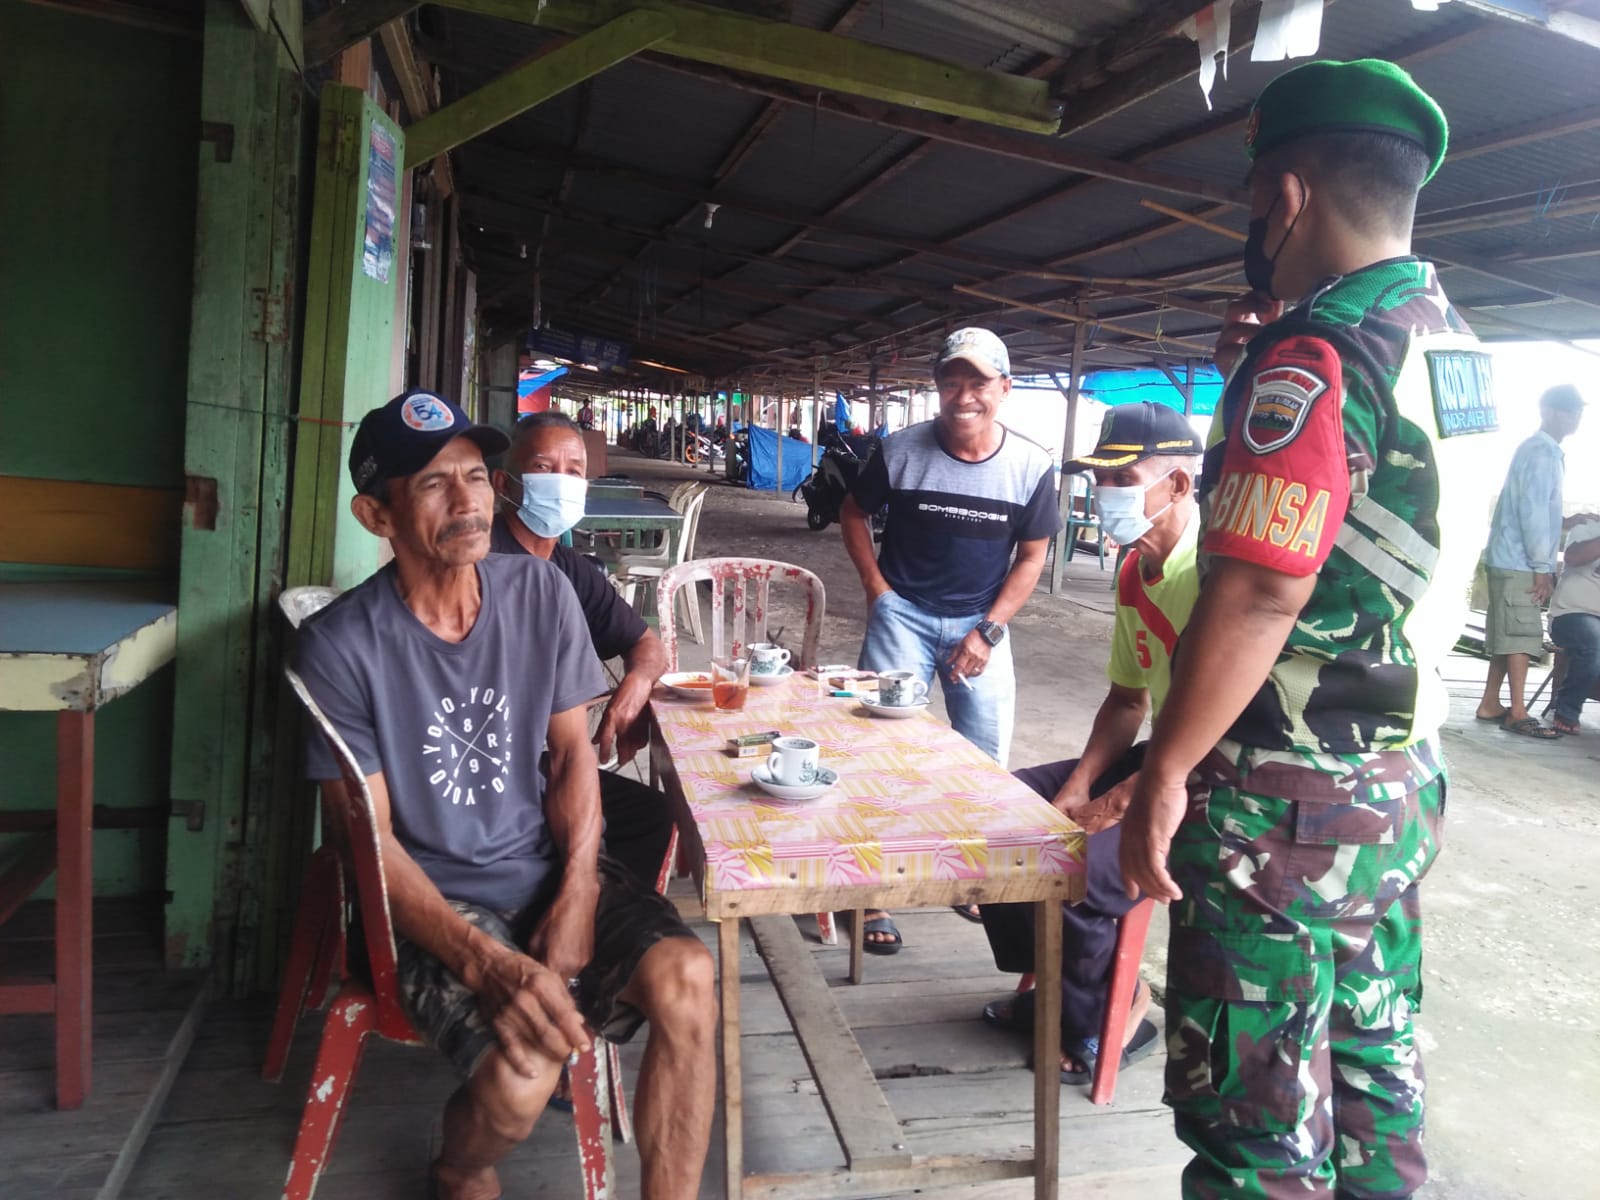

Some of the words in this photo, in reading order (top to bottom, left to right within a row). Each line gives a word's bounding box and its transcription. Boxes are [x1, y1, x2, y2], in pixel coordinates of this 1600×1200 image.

[1135, 630, 1152, 669] 5
[422, 697, 455, 755] YOLO
[463, 718, 473, 733] 8
[486, 733, 498, 748] R
[468, 758, 480, 773] 9
[429, 769, 476, 806] YOLO
